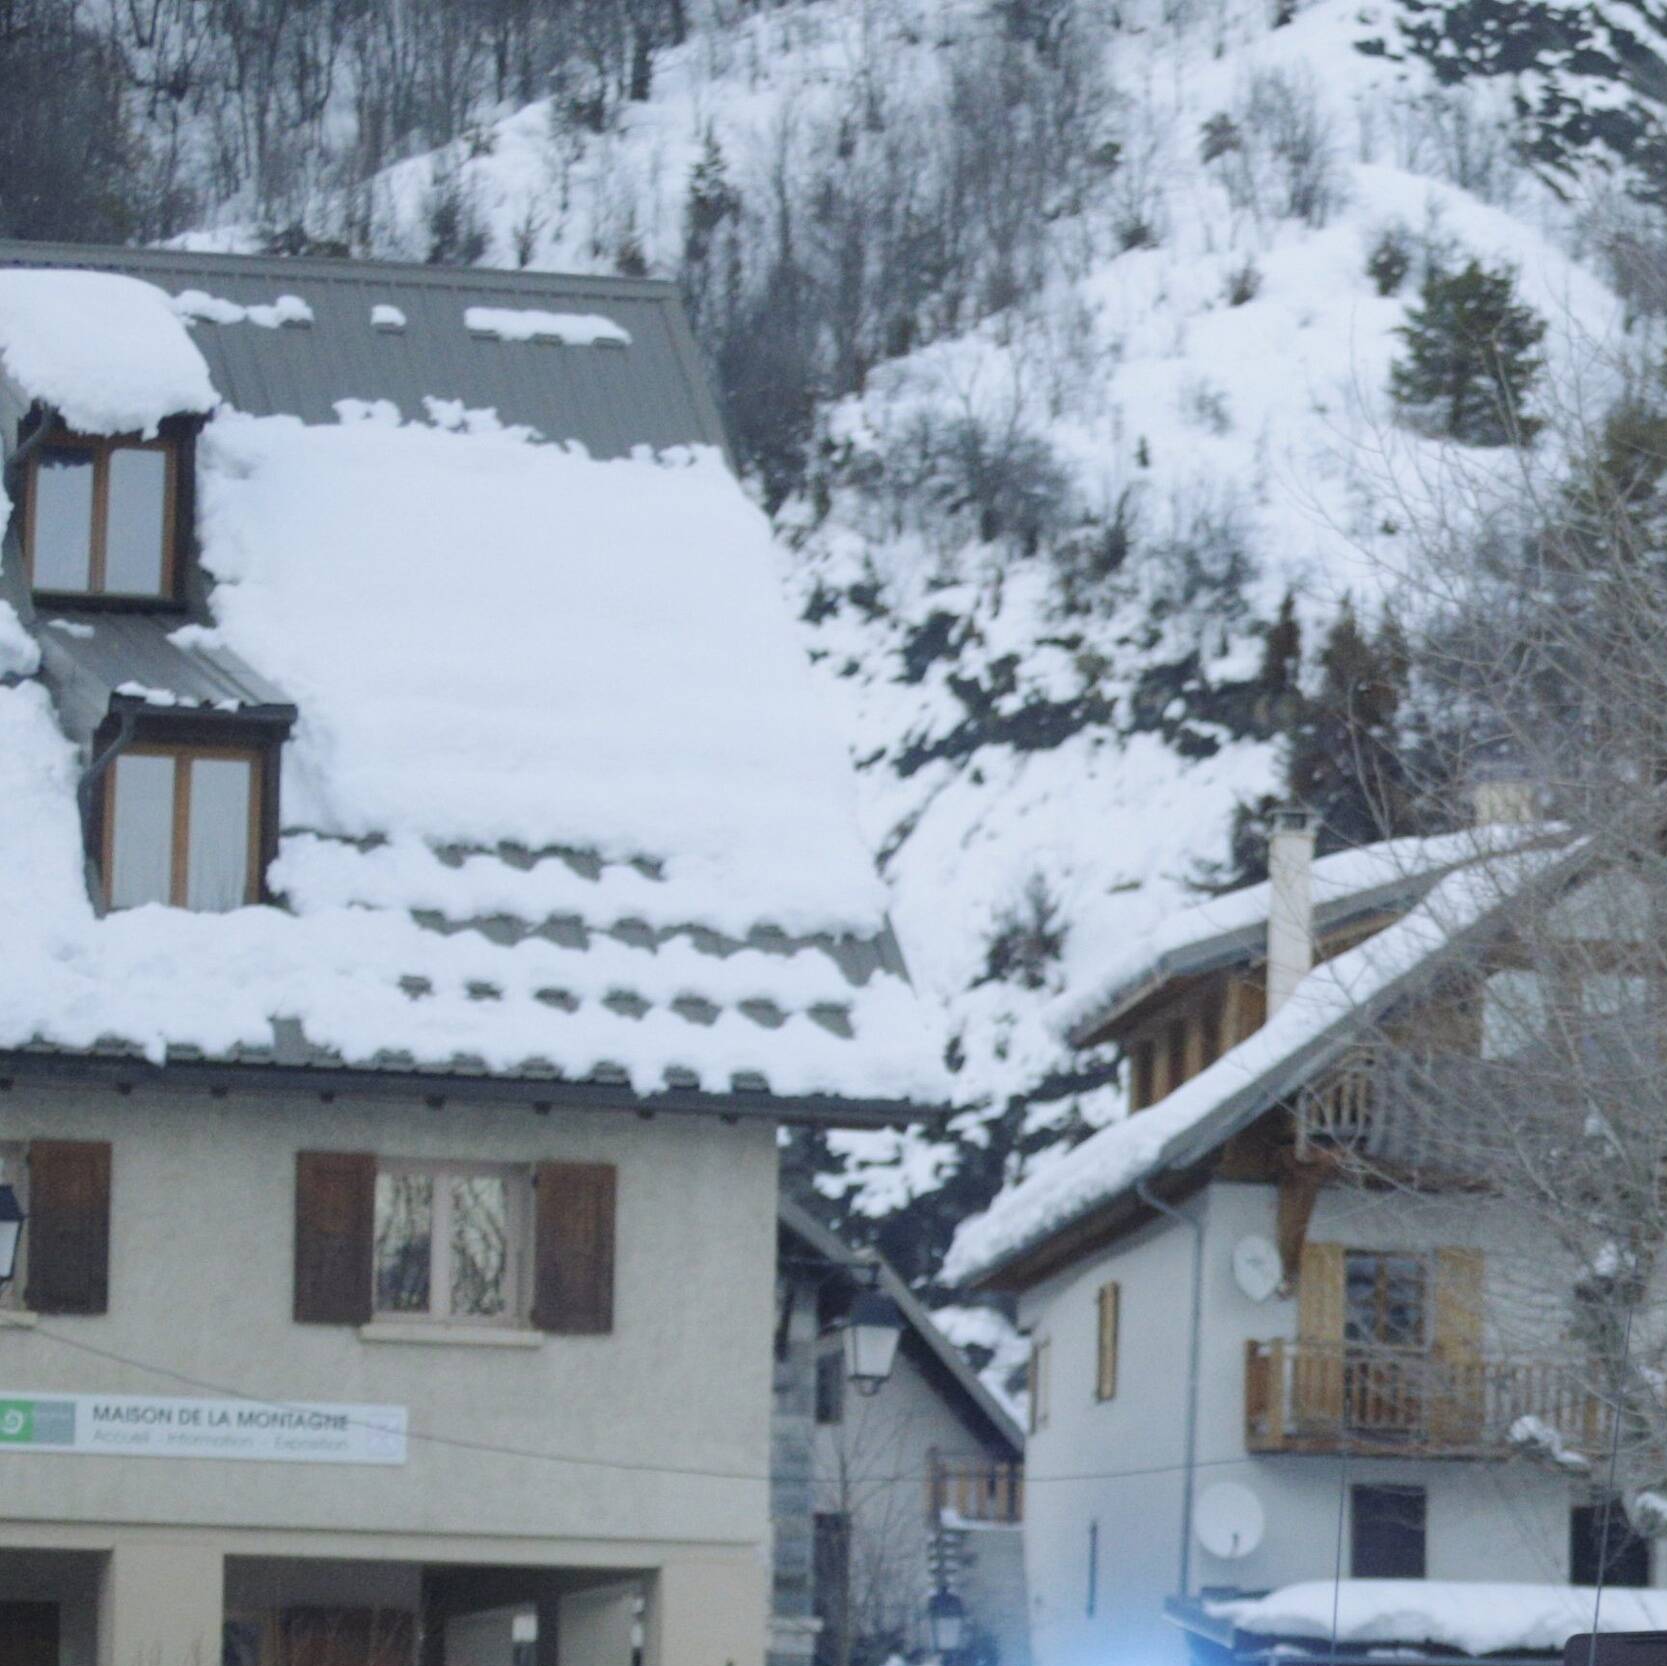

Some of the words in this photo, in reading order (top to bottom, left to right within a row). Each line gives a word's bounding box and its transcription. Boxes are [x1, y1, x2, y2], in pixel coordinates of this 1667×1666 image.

[92, 1405, 172, 1424] MAISON
[178, 1407, 201, 1426] DE
[208, 1409, 229, 1428] LA
[237, 1410, 349, 1431] MONTAGNE
